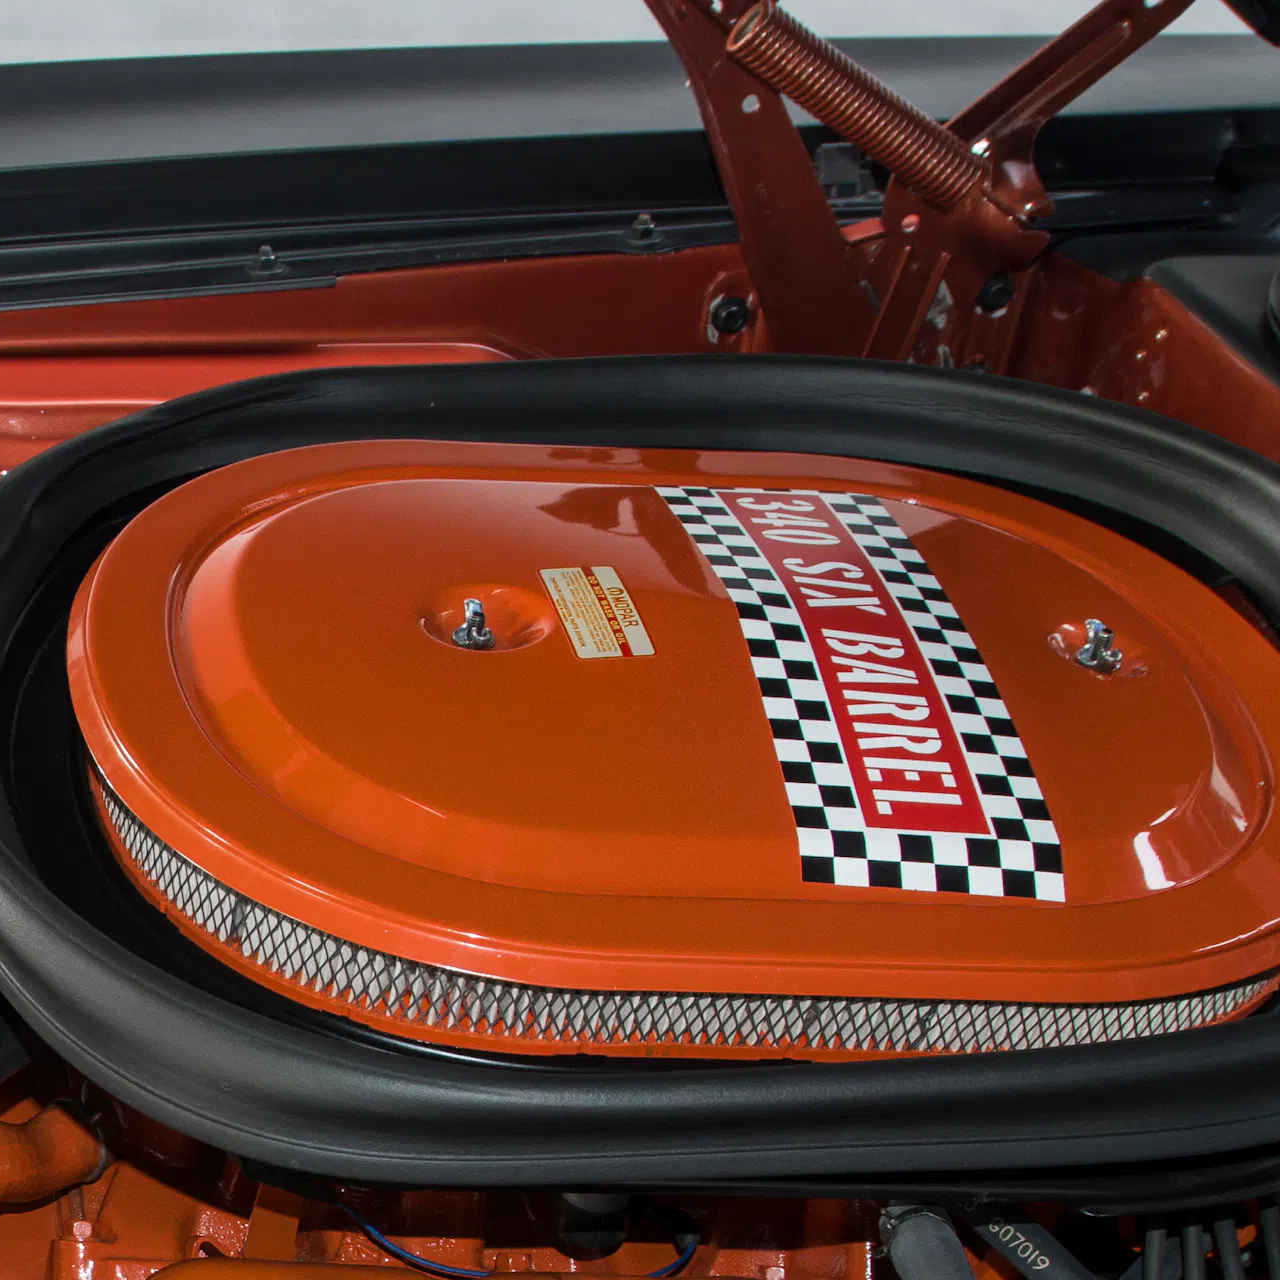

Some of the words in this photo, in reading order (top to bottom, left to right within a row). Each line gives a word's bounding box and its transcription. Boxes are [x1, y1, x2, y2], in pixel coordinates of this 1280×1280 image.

[736, 497, 841, 545] 340
[591, 585, 605, 598] NOT
[782, 557, 887, 616] SIX
[598, 599, 615, 618] WASH
[609, 595, 640, 628] MOPAR
[608, 619, 621, 630] OR
[613, 631, 628, 644] OIL
[821, 628, 963, 815] BARREL
